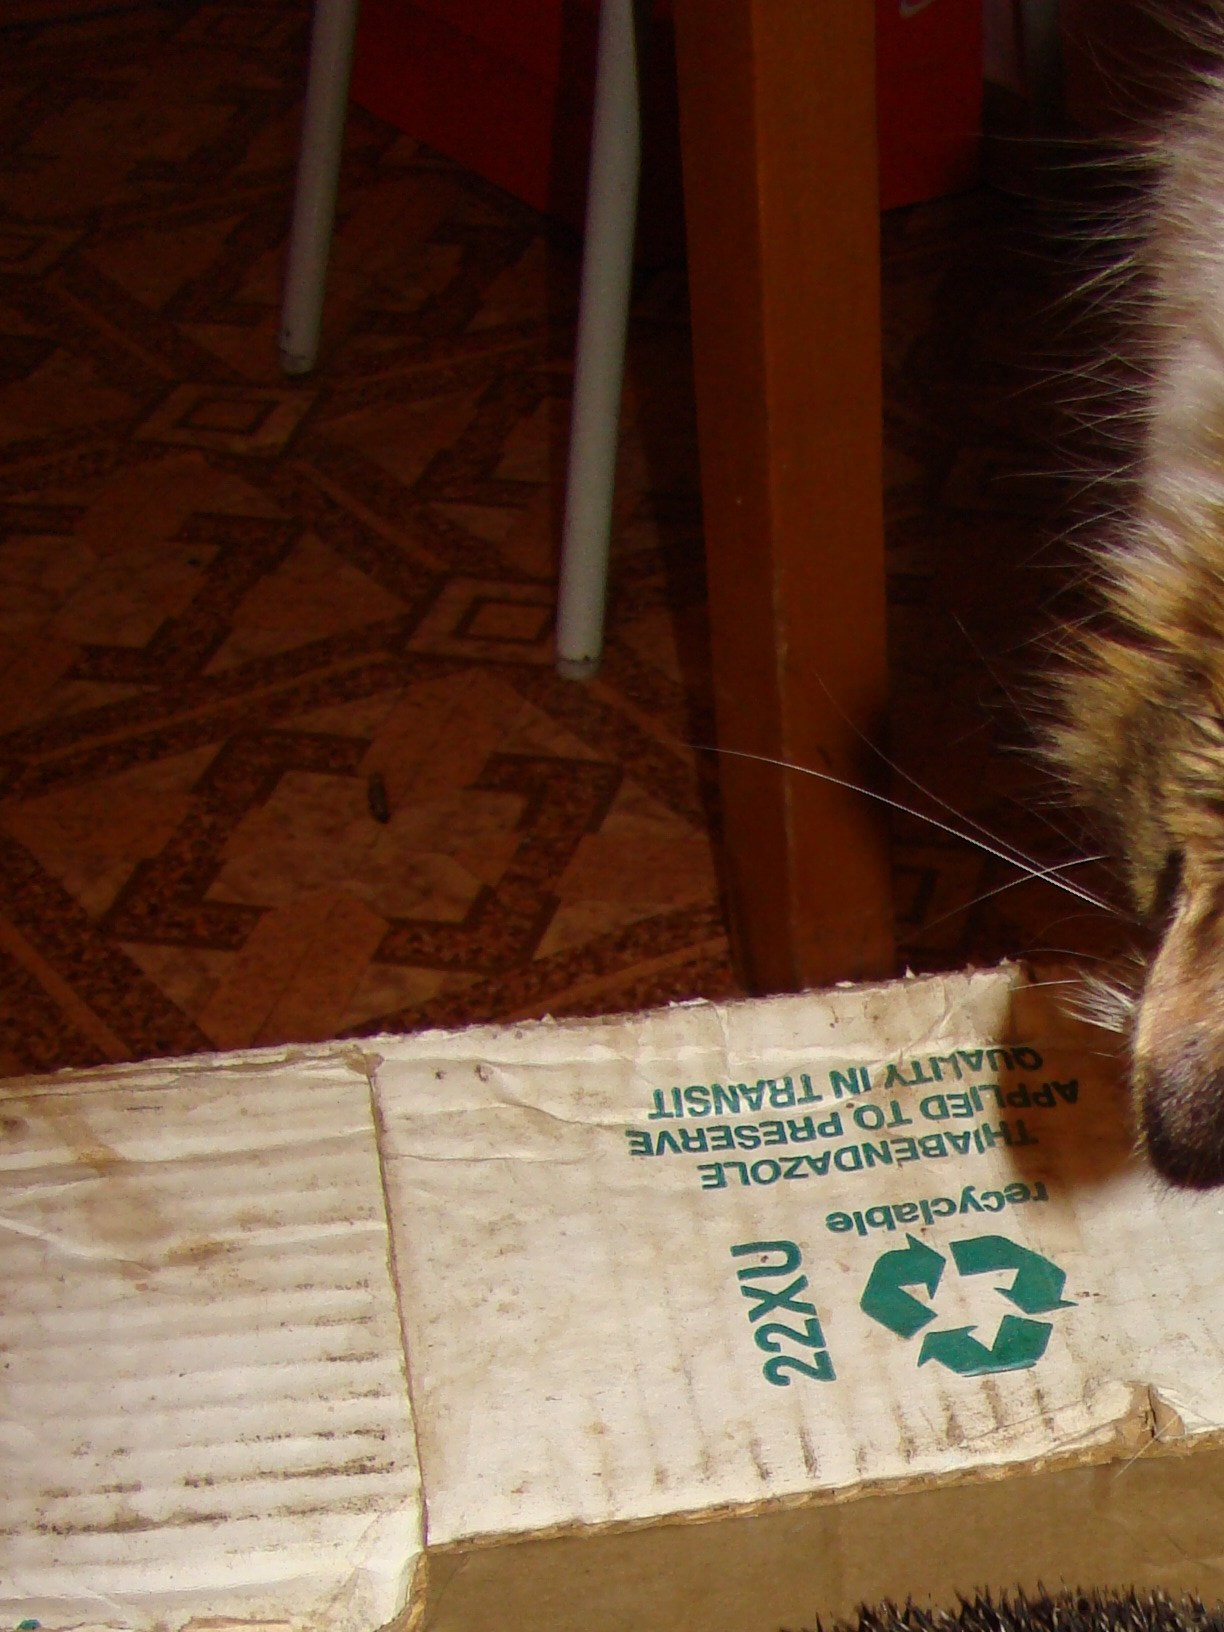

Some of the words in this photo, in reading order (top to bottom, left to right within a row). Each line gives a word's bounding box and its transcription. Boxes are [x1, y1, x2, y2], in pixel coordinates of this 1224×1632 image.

[830, 1065, 872, 1099] IN
[884, 1046, 1043, 1089] QUALITY
[647, 1073, 823, 1120] TRANSIT
[853, 1099, 913, 1132] TO
[919, 1077, 1079, 1121] APPLIED
[625, 1112, 844, 1157] PRESERVE
[697, 1119, 1039, 1190] THIABENDAZOLE
[825, 1181, 1050, 1236] recyclable
[730, 1240, 837, 1387] 22XU
